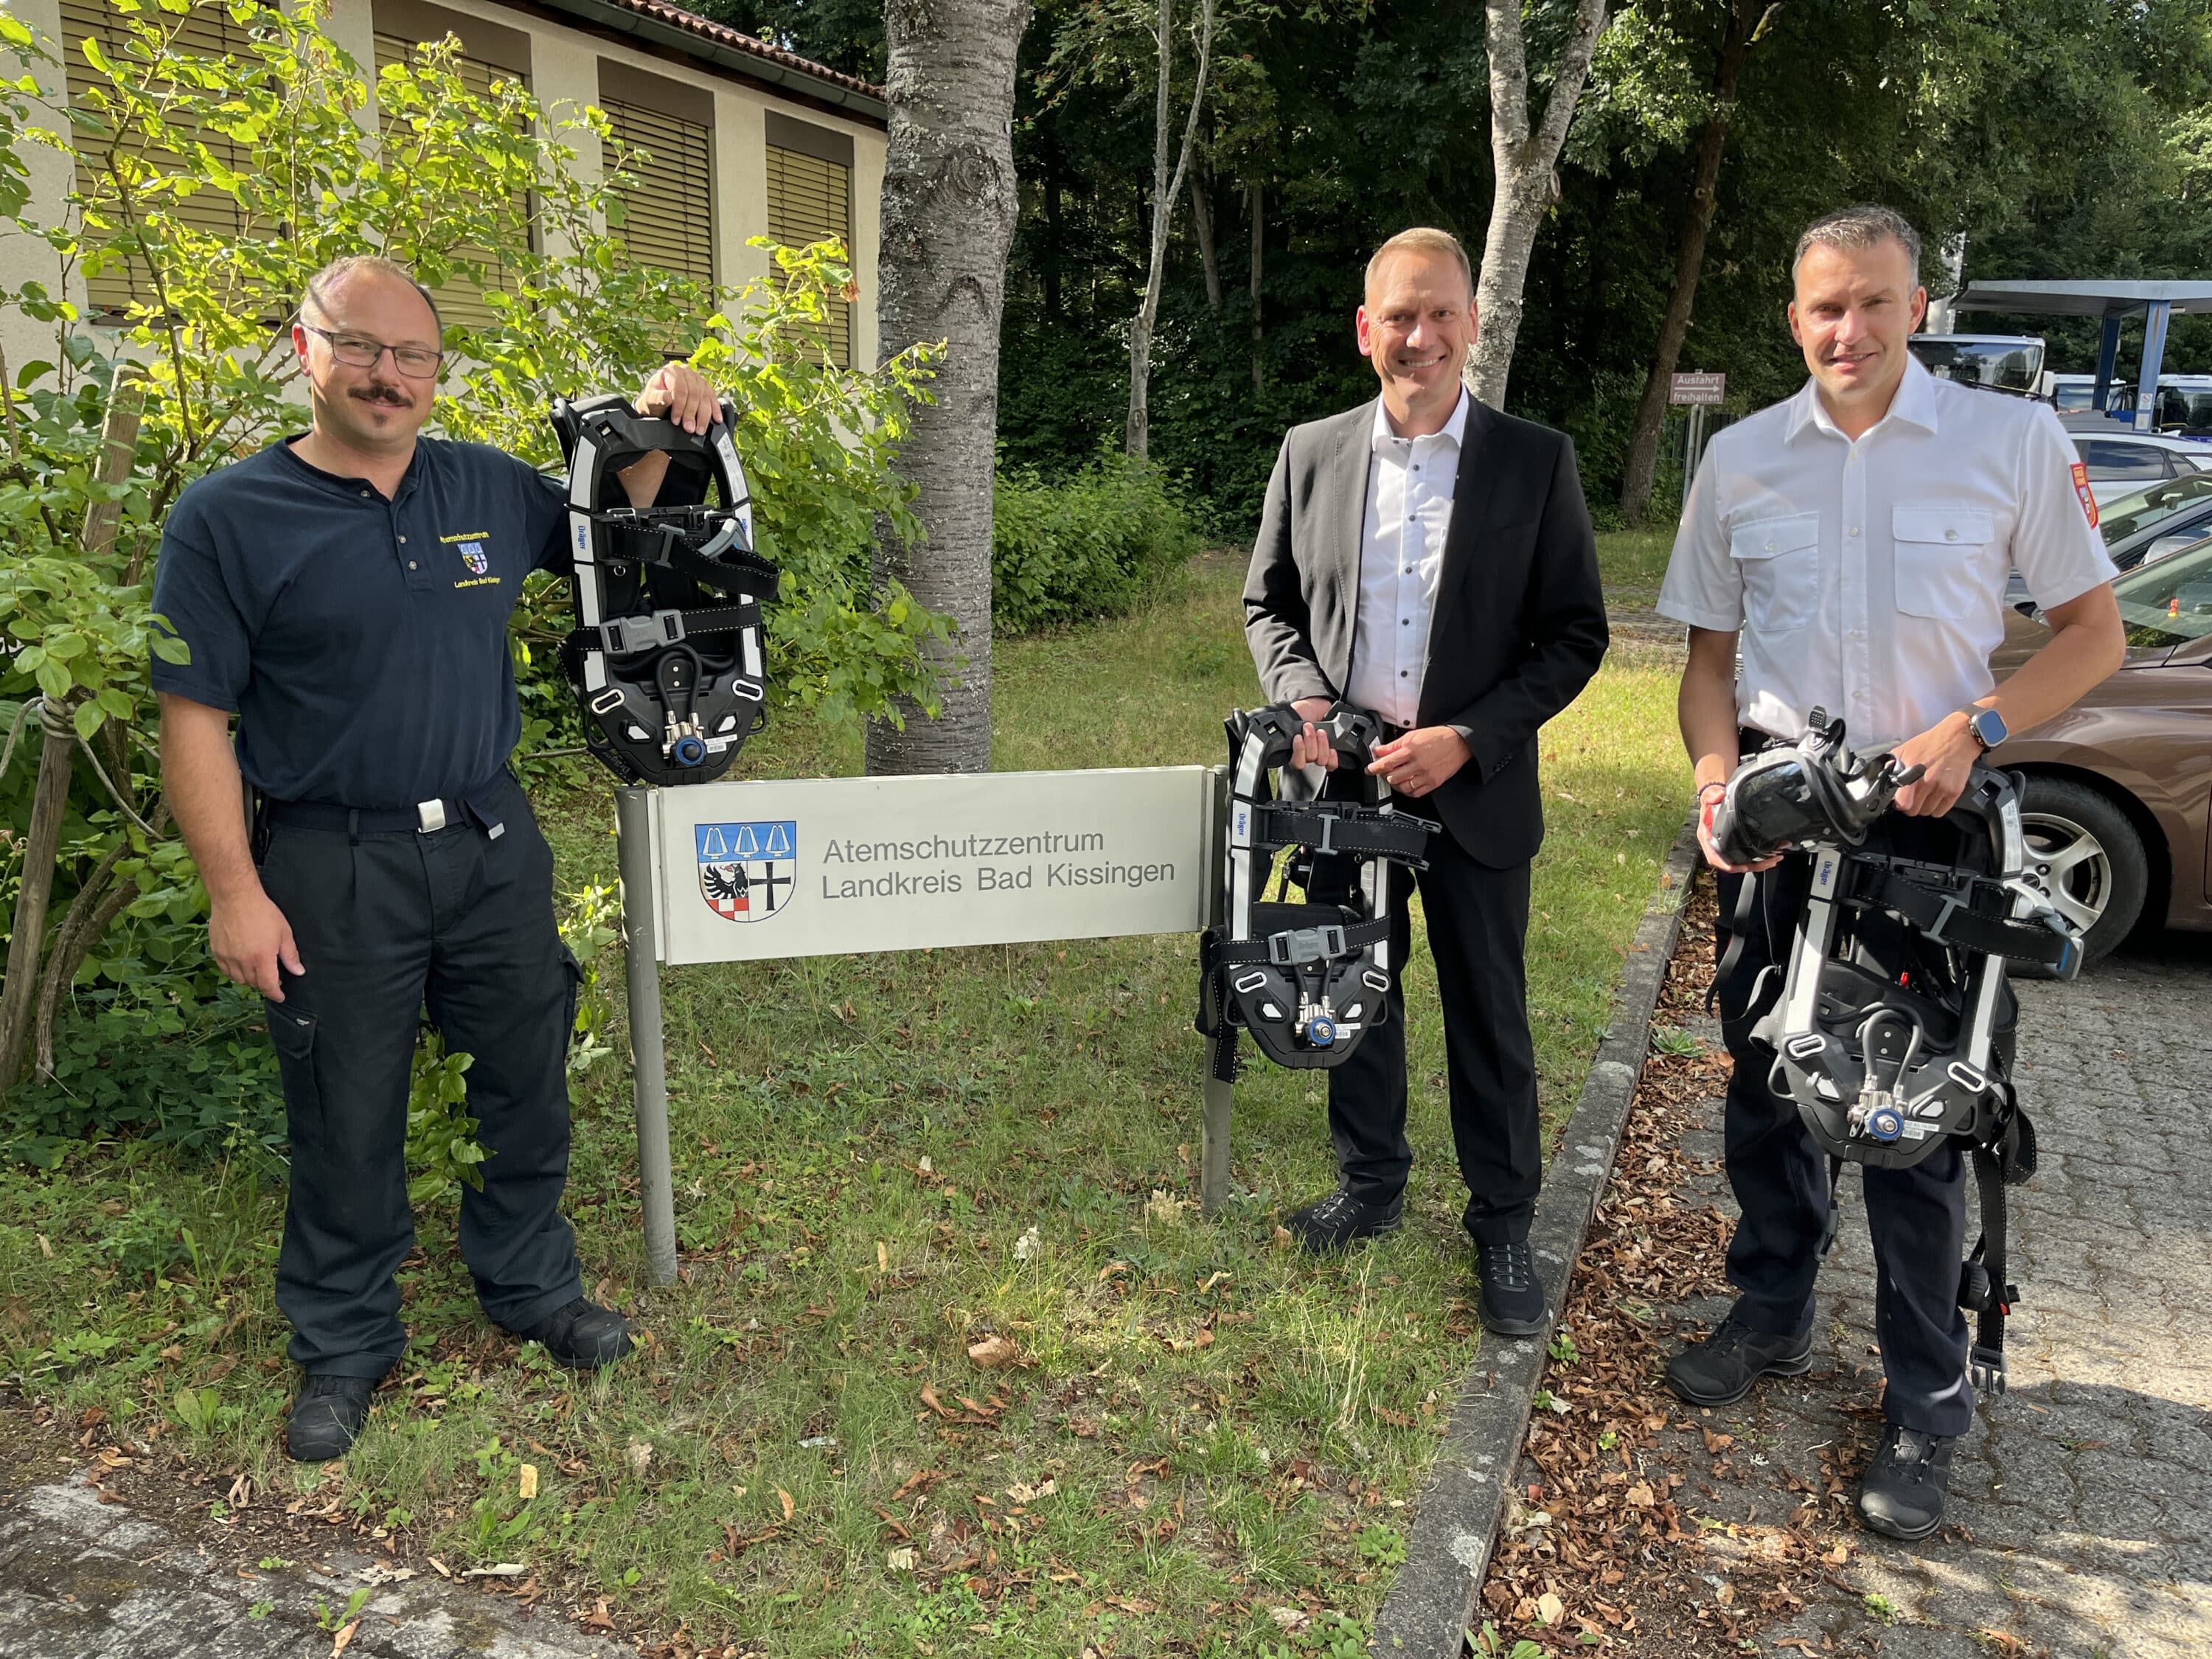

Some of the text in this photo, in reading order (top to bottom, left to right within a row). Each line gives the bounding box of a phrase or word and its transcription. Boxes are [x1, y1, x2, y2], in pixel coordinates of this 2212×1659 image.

[1677, 375, 1719, 384] Ausfahrt
[1673, 392, 1720, 402] freihalten
[577, 525, 587, 550] Dräger
[1237, 813, 1246, 837] Dräger
[822, 830, 1105, 864] Atemschutzzentrum
[822, 860, 1175, 900] Landkreis Bad Kissingen
[1820, 860, 1833, 886] Dräger
